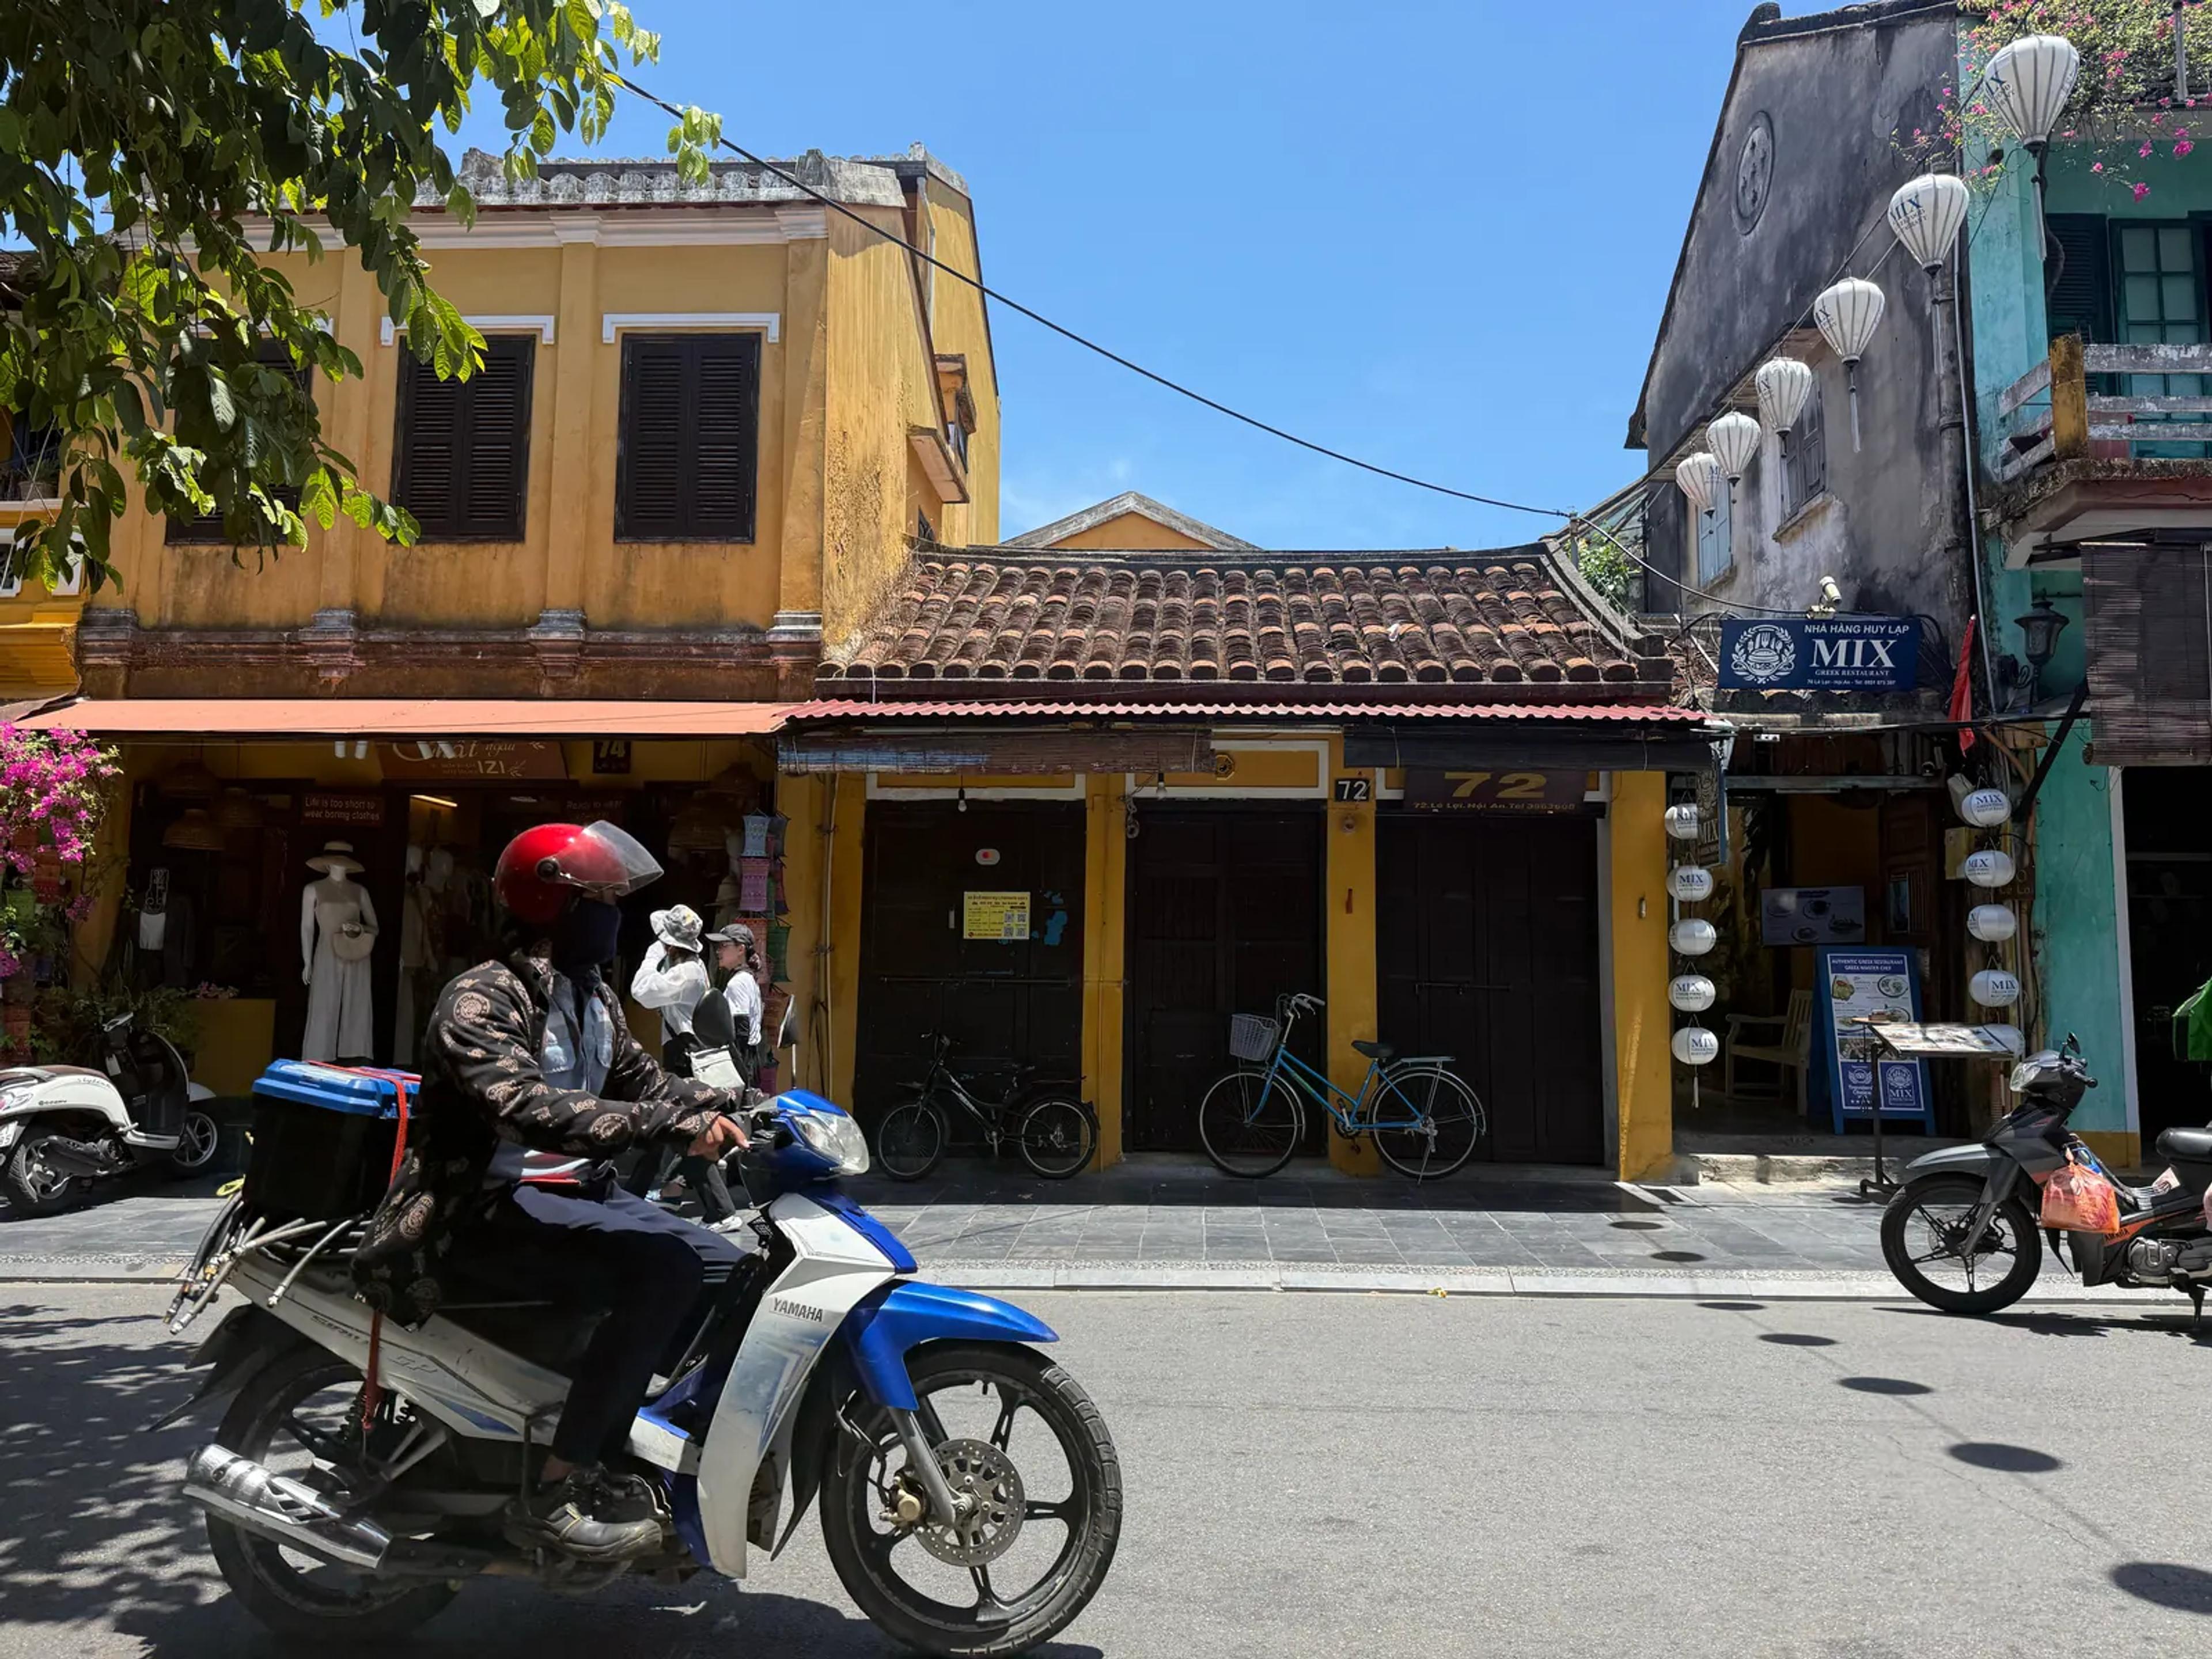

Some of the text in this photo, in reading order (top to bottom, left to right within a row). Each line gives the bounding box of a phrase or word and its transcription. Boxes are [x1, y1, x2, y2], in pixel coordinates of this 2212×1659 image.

[1804, 622, 1910, 636] NHÀ HÀNG HUY LẠP
[1809, 639, 1897, 668] MIX
[1338, 781, 1367, 800] 72
[1444, 771, 1547, 799] 72
[330, 798, 344, 808] too
[345, 799, 365, 809] short
[367, 800, 376, 809] to
[1976, 794, 2002, 804] MIX
[324, 810, 350, 821] boring
[351, 810, 380, 820] clothes
[1679, 875, 1703, 883] MIX
[1676, 983, 1700, 992] MIX
[1991, 980, 2016, 989] MIX
[1691, 1038, 1714, 1047] MIX
[1890, 1089, 1912, 1097] MIX
[774, 1297, 823, 1322] YAMAHA
